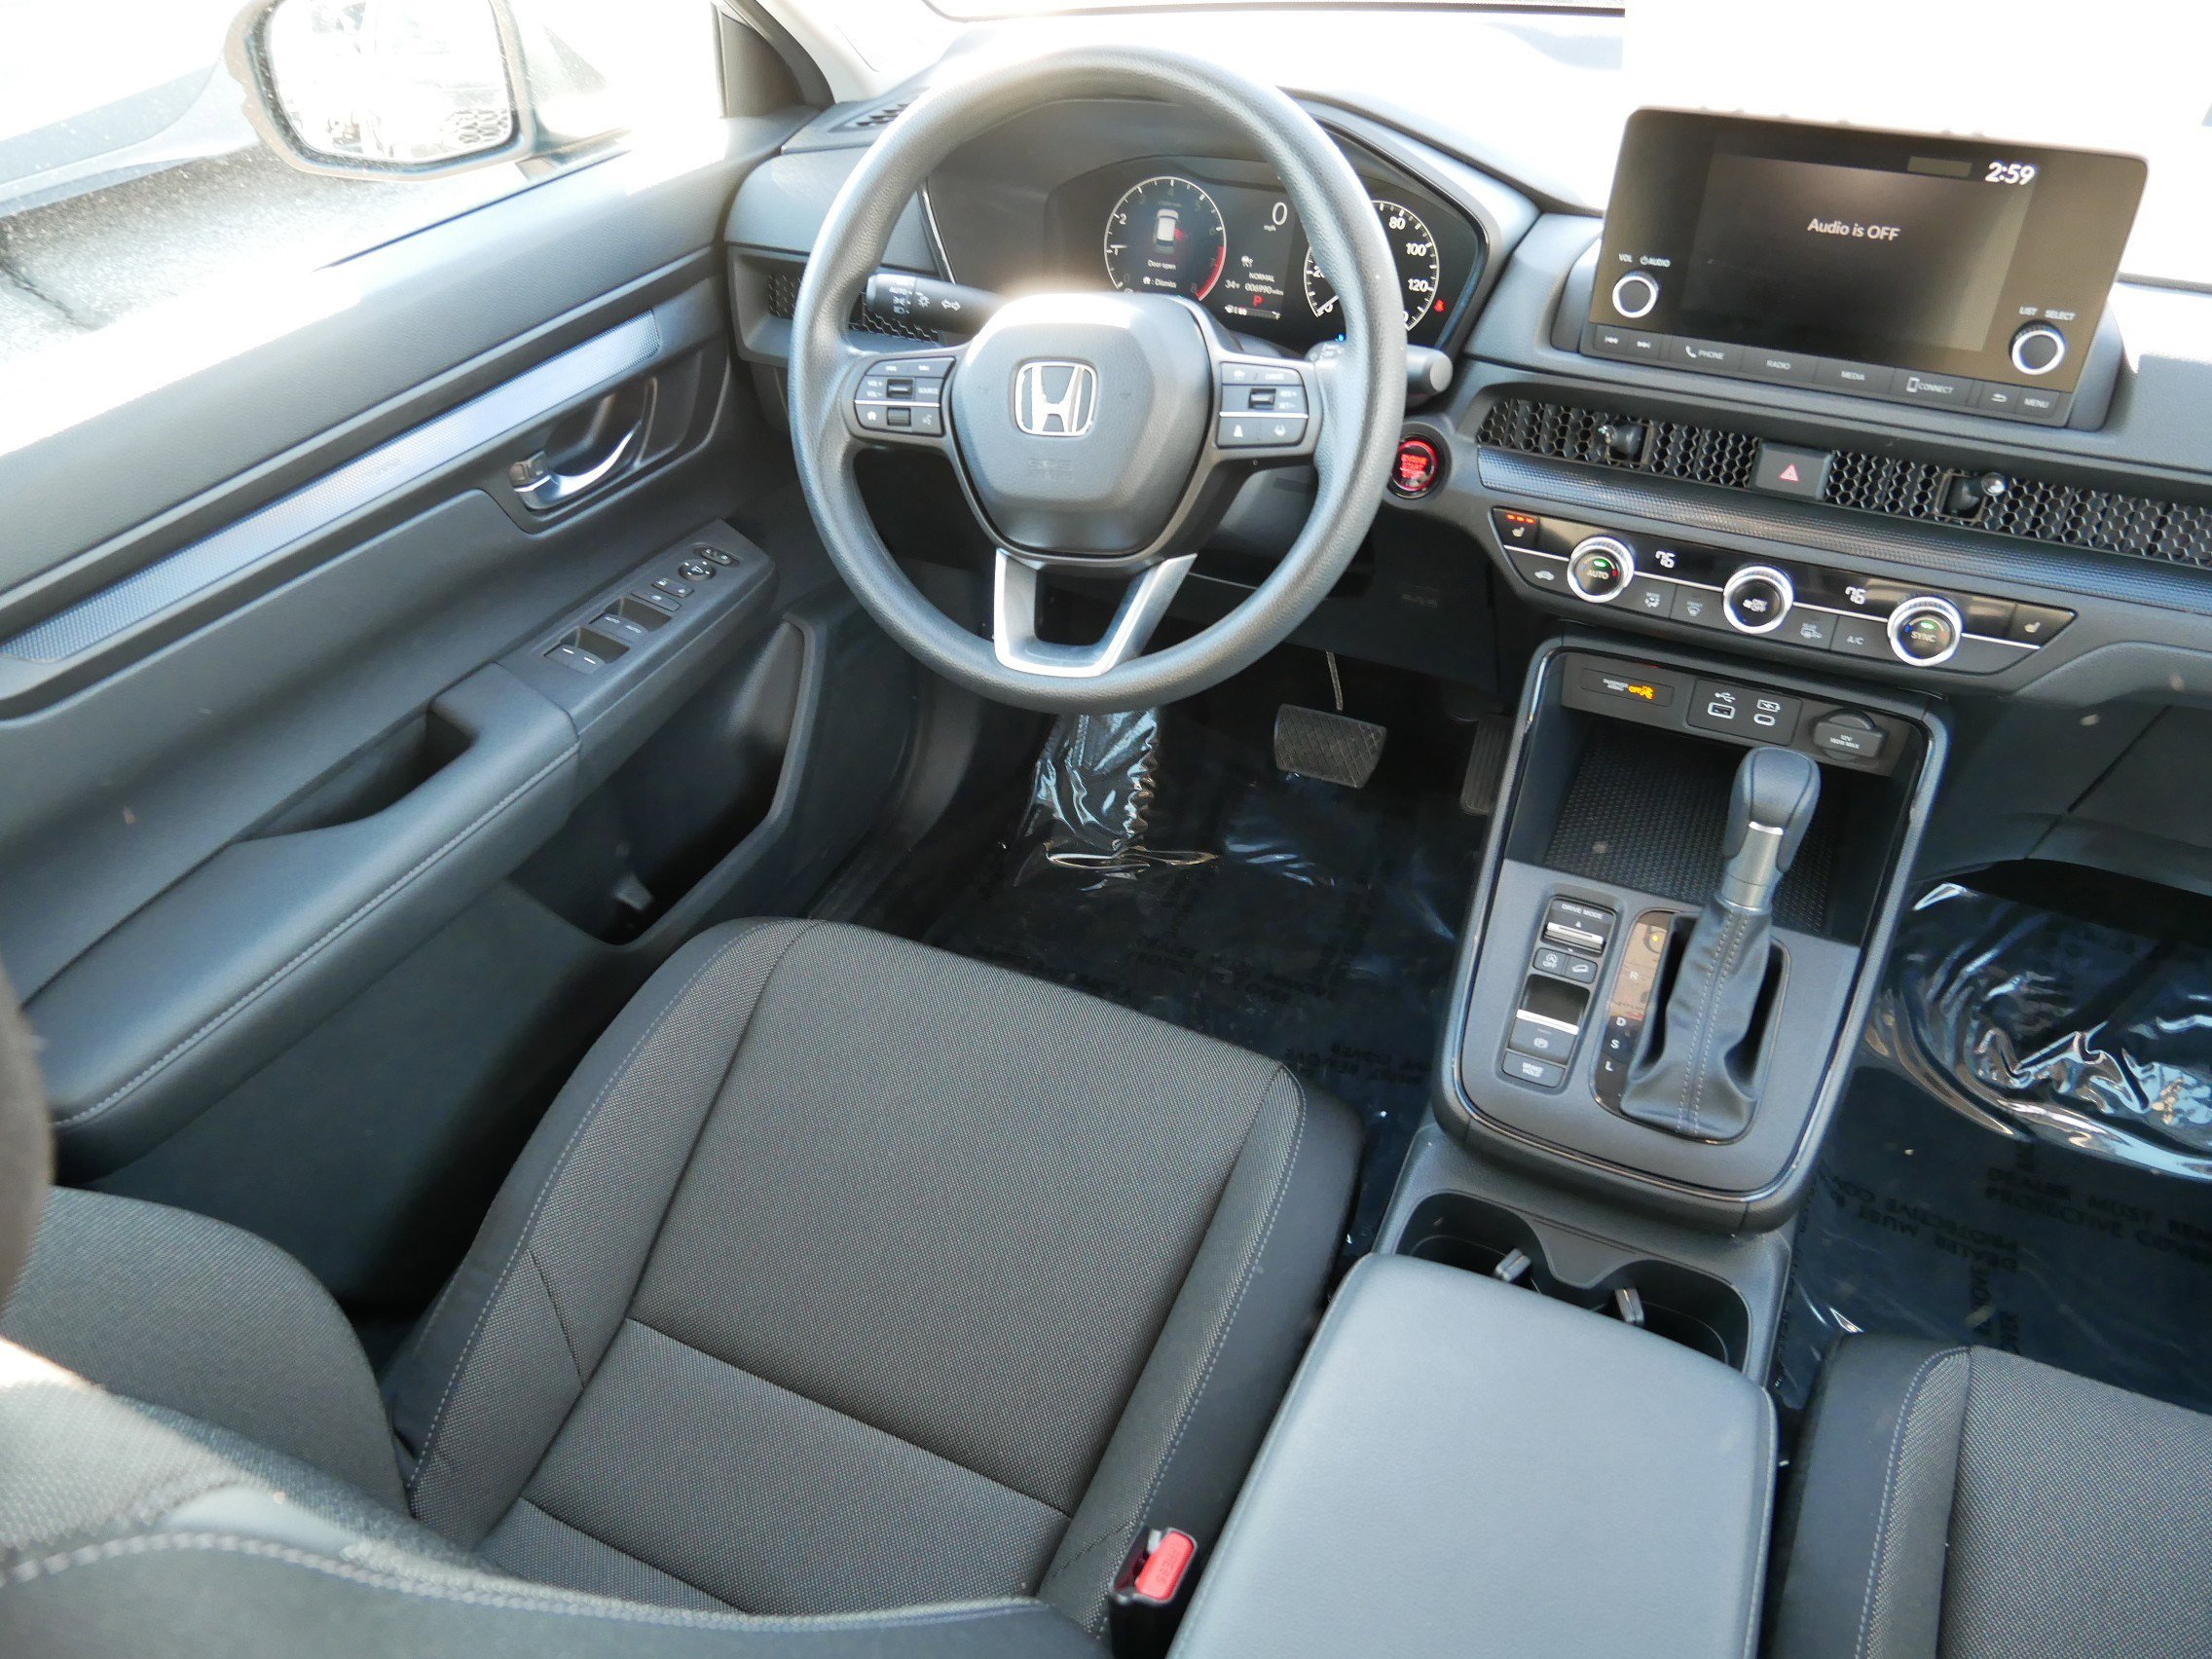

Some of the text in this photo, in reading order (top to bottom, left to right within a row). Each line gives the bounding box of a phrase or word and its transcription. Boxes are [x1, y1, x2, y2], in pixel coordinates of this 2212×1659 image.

[1984, 161, 2037, 186] 2:59
[1119, 213, 1127, 225] 2
[1272, 202, 1288, 226] 0
[1388, 216, 1406, 231] 80
[1807, 217, 1900, 242] Audio is OFF
[1405, 242, 1427, 257] 100
[1408, 278, 1429, 293] 120
[1253, 295, 1264, 307] P
[1698, 349, 1725, 360] PHONE
[1766, 359, 1791, 371] RADIO
[1840, 370, 1866, 382] MEDIA
[1917, 382, 1955, 394] CONNECT
[2024, 397, 2049, 409] MENU
[1586, 569, 1609, 580] AUTO
[1846, 634, 1865, 646] A/C
[1910, 630, 1937, 644] SYNC
[1561, 903, 1604, 921] DRIVE MODE
[1615, 1016, 1627, 1027] D
[1610, 1039, 1620, 1051] S
[1604, 1060, 1614, 1073] L
